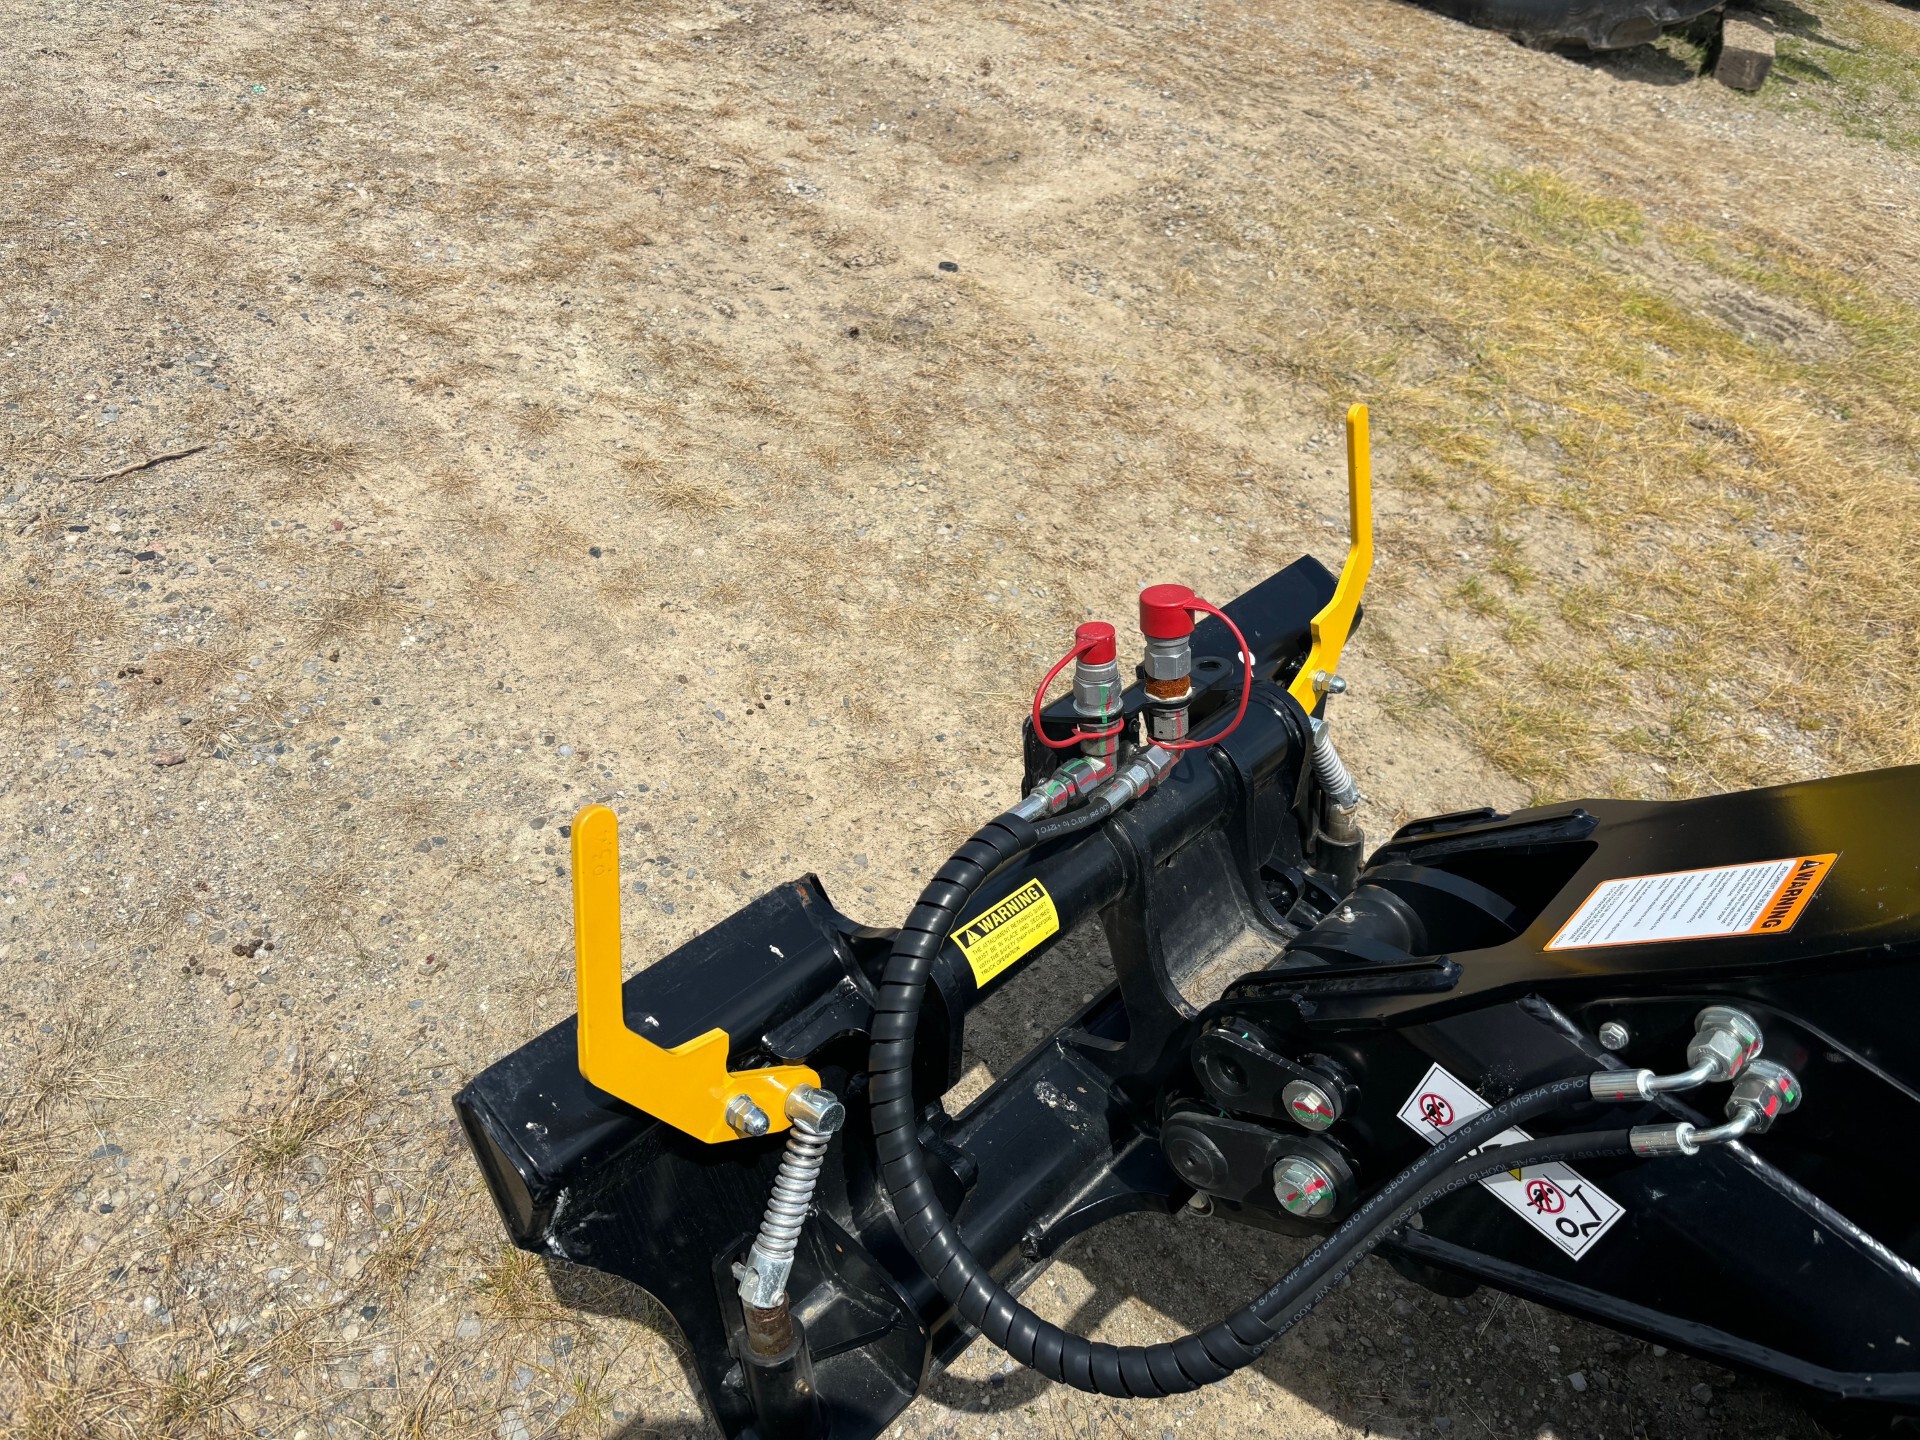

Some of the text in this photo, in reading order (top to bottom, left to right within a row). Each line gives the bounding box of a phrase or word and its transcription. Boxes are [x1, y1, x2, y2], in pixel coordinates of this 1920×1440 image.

[976, 886, 1040, 932] WARNING
[1760, 870, 1815, 927] WARNING
[972, 946, 982, 955] THE
[981, 926, 1010, 949] ATTACHMENT
[1010, 910, 1033, 929] RETAINING
[1032, 901, 1046, 914] SHAFT
[975, 950, 988, 962] MUST
[989, 944, 997, 953] BE
[1003, 929, 1018, 942] PLACE
[1019, 922, 1029, 932] AND
[1029, 907, 1050, 924] SECURED
[978, 957, 990, 969] WITH
[990, 951, 999, 961] THE
[999, 939, 1015, 954] SAFETY
[1035, 914, 1052, 929] BEFORE
[980, 962, 996, 975] TRUCK
[1510, 1156, 1536, 1168] SAE
[1283, 1266, 1300, 1284] WP
[1301, 1248, 1322, 1266] 400
[1322, 1234, 1338, 1250] bar
[1360, 1193, 1383, 1215] MPa
[1411, 1157, 1427, 1172] psi
[1459, 1125, 1472, 1136] to
[1509, 1087, 1548, 1108] MSHA
[1391, 1206, 1415, 1227] 2SC
[1292, 1303, 1311, 1321] 400
[1313, 1285, 1331, 1302] WP
